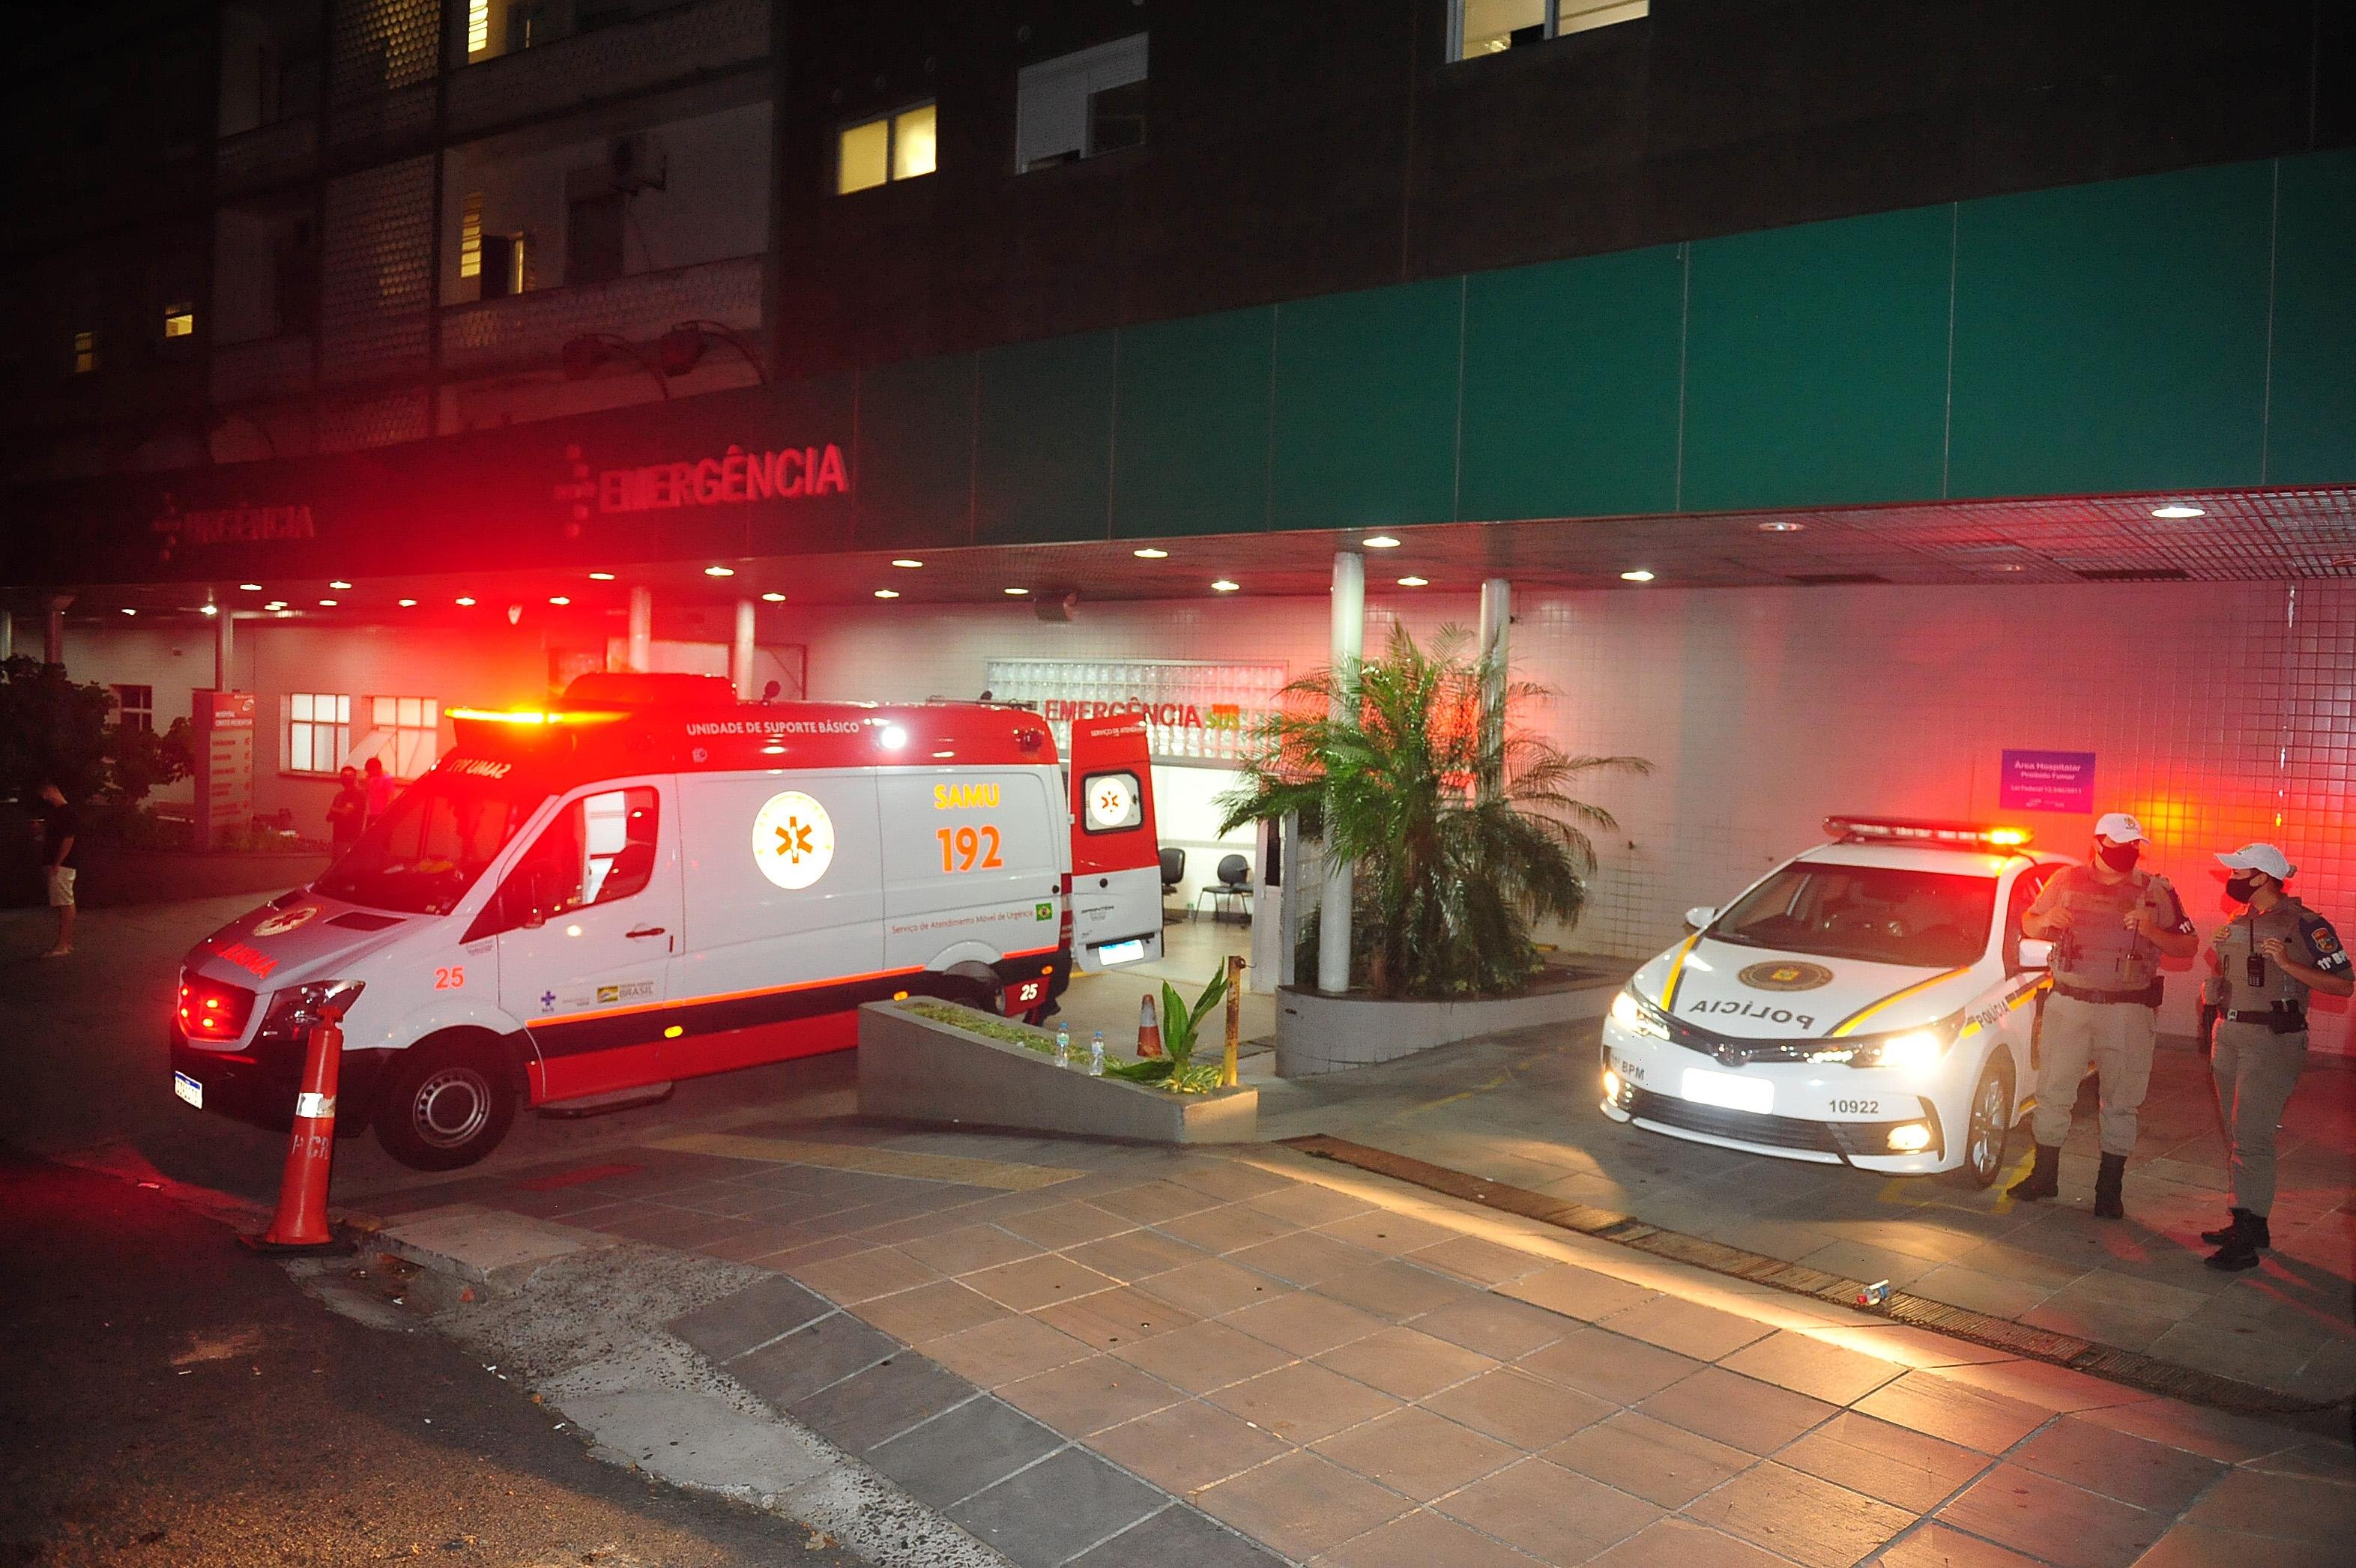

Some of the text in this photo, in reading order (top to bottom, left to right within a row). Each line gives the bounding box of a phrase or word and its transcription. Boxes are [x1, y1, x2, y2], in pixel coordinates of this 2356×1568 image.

[600, 443, 848, 513] EMERGÊNCIA
[686, 719, 860, 736] UNIDADE DE SUPORTE BÁSICO
[934, 783, 1000, 809] SAMU
[936, 824, 1003, 874] 192
[919, 922, 928, 930] de
[930, 917, 975, 928] Atendimento
[997, 911, 1005, 921] de
[435, 966, 465, 990] 25
[1020, 983, 1039, 1001] 25
[1622, 1060, 1645, 1080] BPM
[1829, 1099, 1879, 1115] 10922
